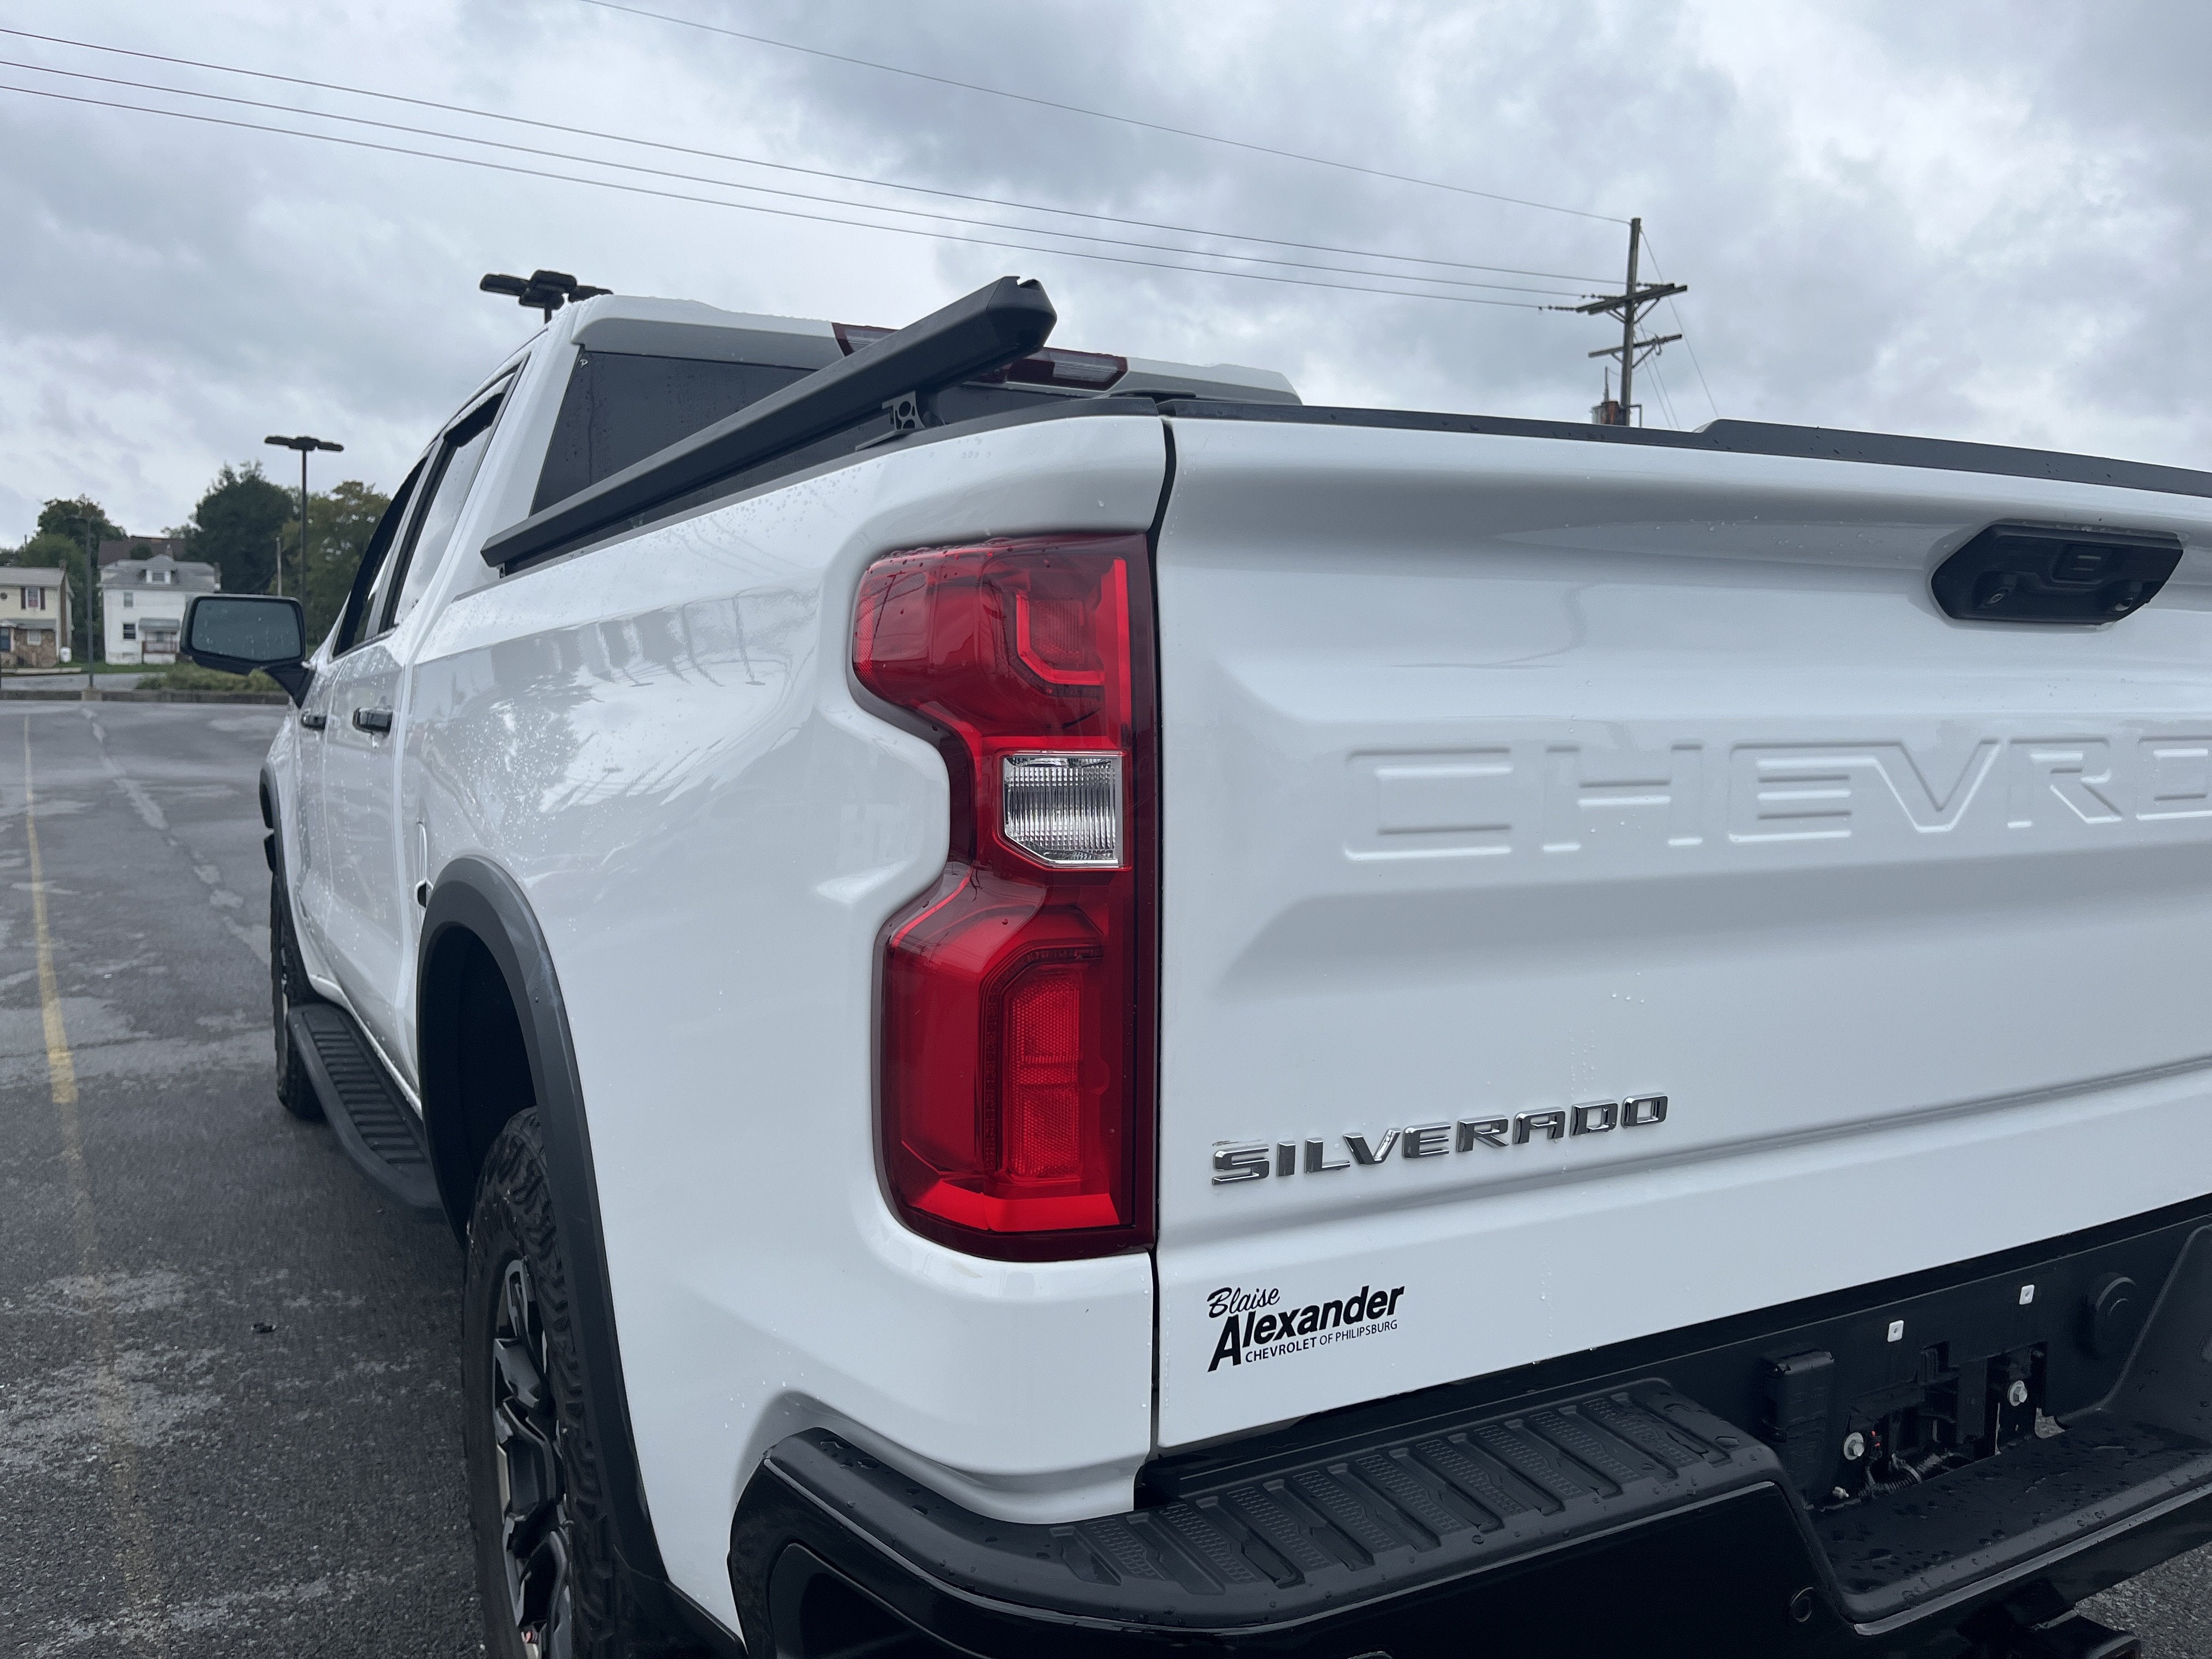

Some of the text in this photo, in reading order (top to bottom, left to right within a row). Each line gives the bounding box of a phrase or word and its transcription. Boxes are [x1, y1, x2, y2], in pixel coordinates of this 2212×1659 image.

[1211, 1092, 1669, 1186] SILVERADO
[1206, 1286, 1280, 1318] Blaise
[1207, 1285, 1406, 1373] Alexander
[1245, 1319, 1398, 1363] CHEVROLET OF PHILIPSBURG
